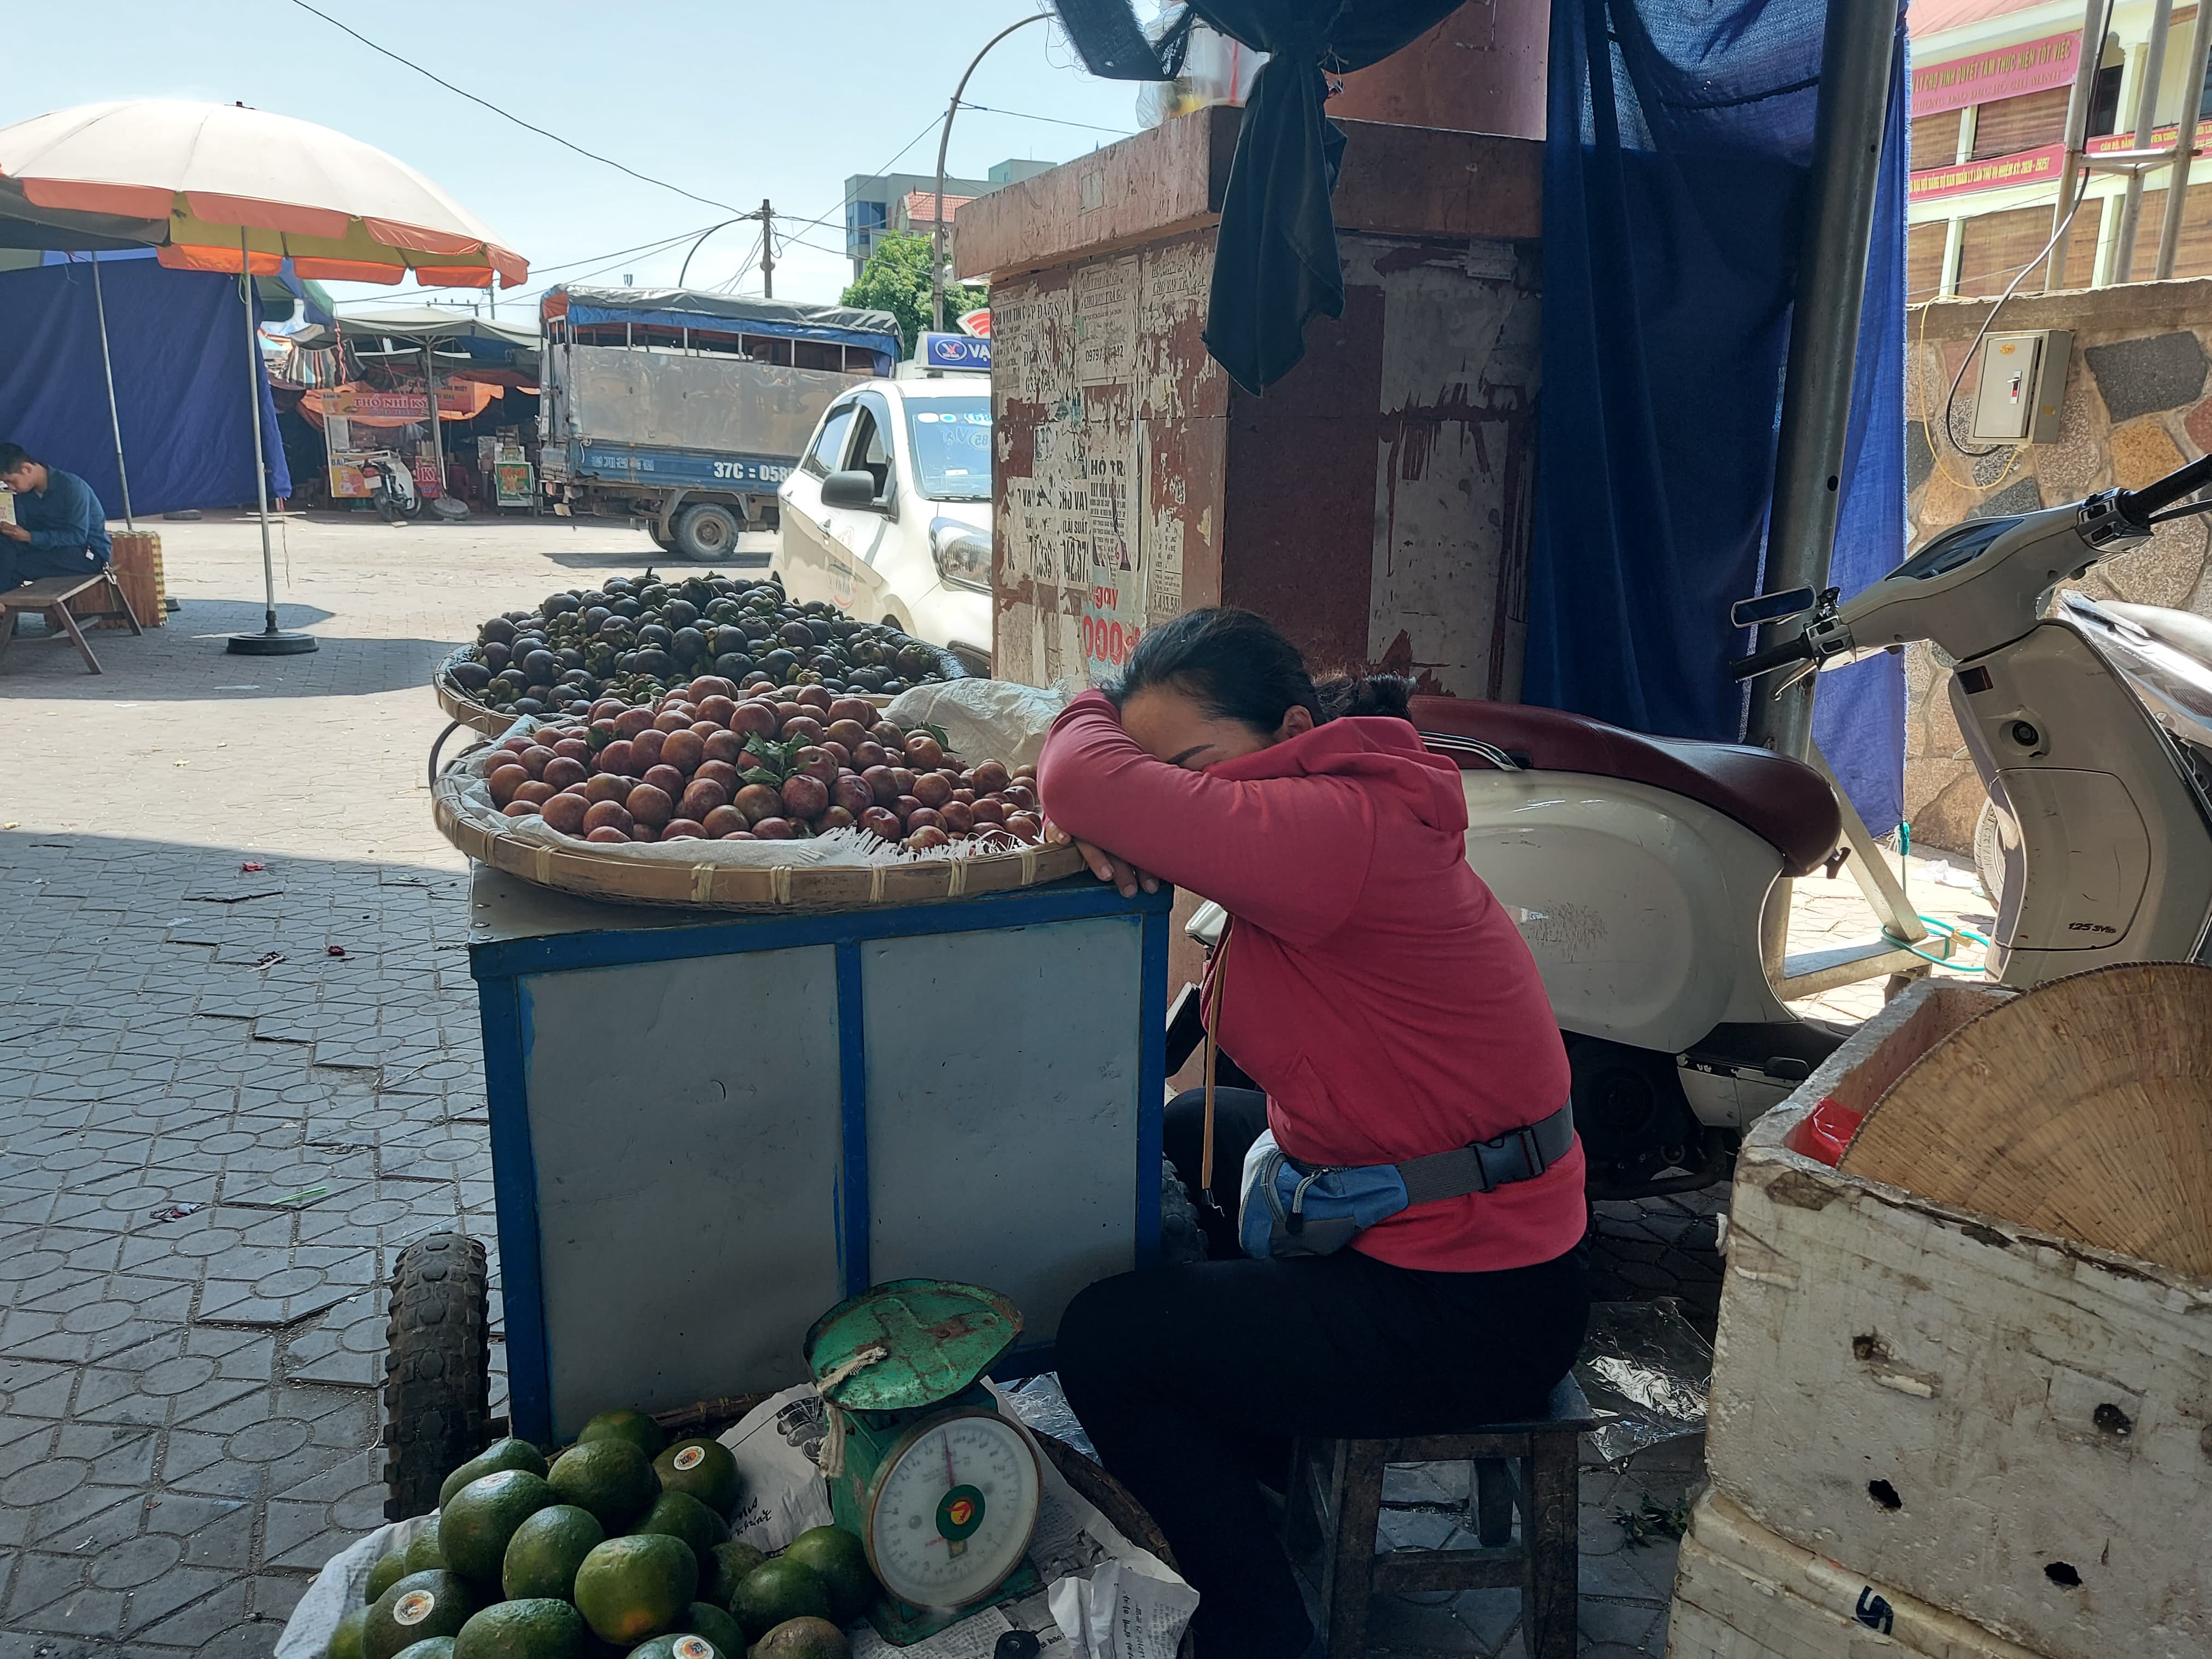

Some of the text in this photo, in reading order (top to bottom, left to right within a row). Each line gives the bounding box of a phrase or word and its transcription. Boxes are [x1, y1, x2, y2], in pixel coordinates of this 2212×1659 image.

[2053, 39, 2071, 62] VIỆC
[713, 461, 743, 479] 37C
[2069, 922, 2094, 931] 125
